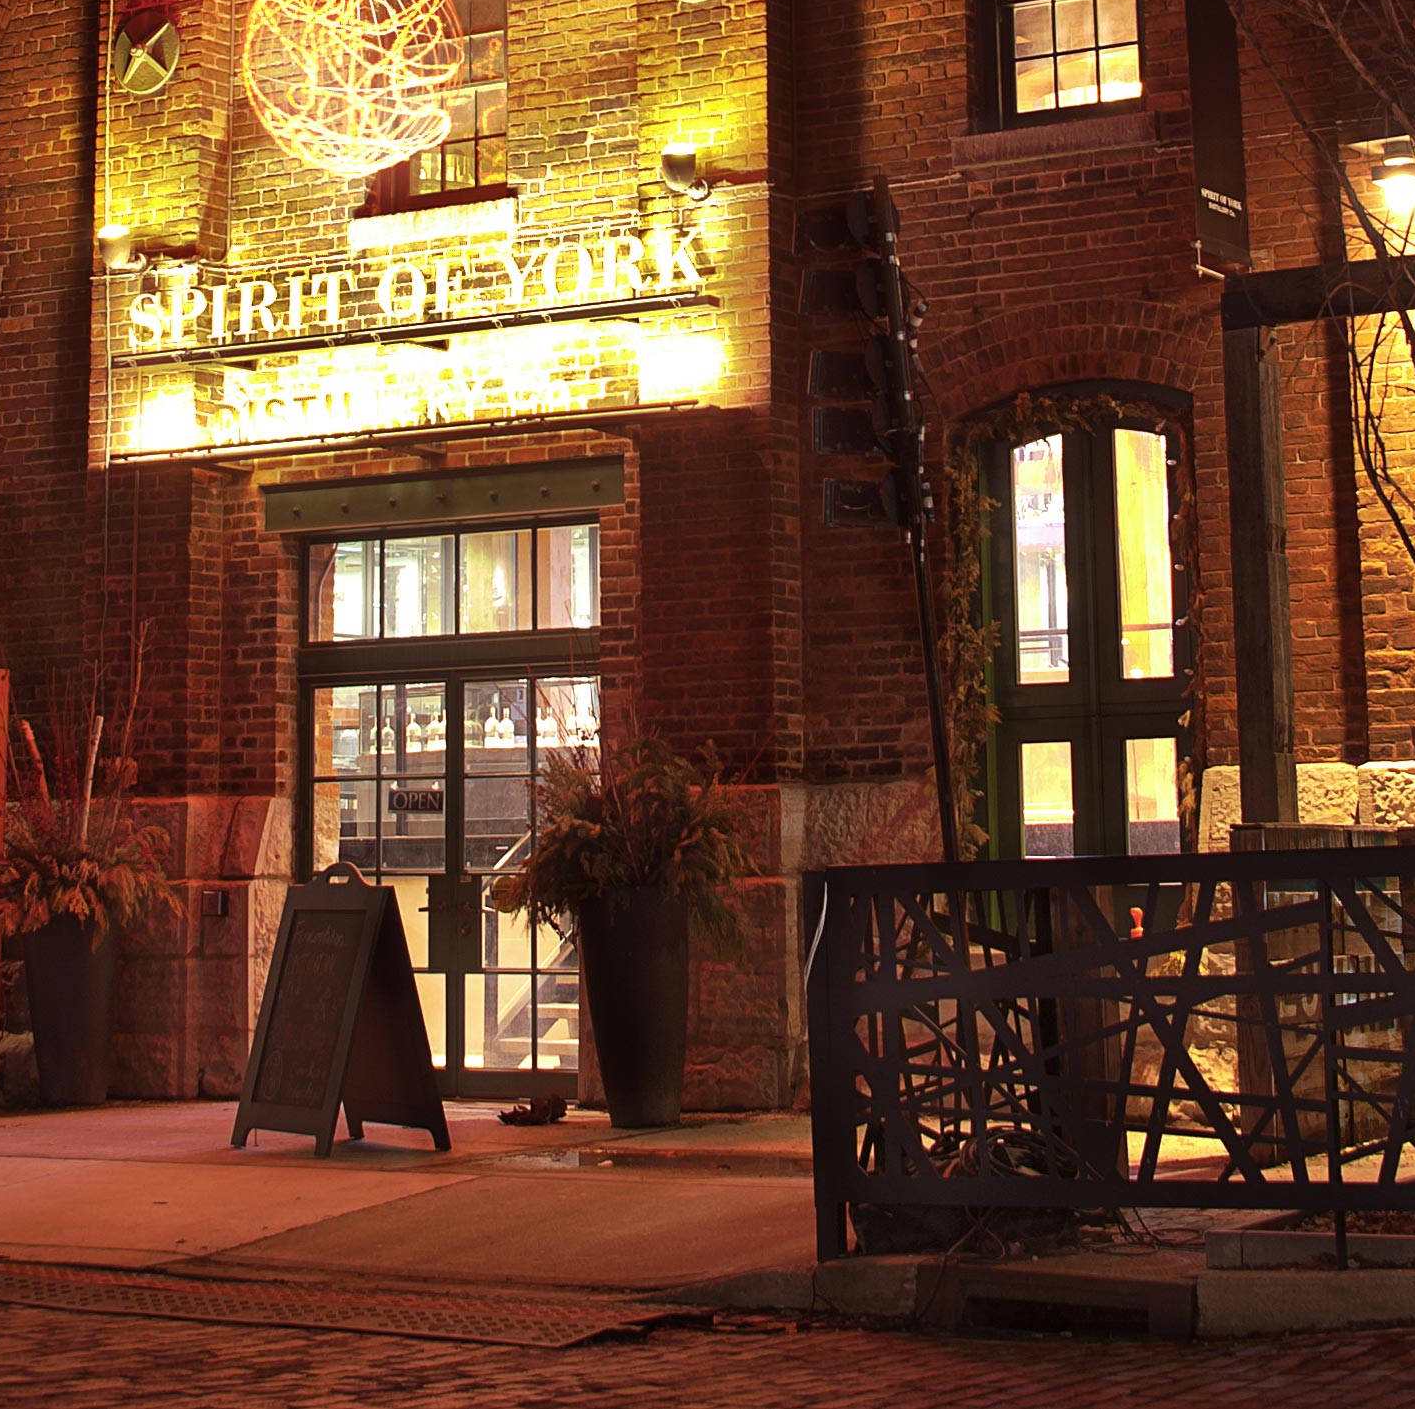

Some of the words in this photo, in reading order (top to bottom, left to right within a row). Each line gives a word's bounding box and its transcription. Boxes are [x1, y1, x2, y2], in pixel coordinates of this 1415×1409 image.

[1201, 187, 1220, 202] SPIRIT
[1228, 197, 1242, 211] YORK
[128, 271, 356, 345] SPIRIT
[378, 254, 471, 319] OF
[495, 226, 706, 304] YORK
[393, 792, 440, 809] OPEN
